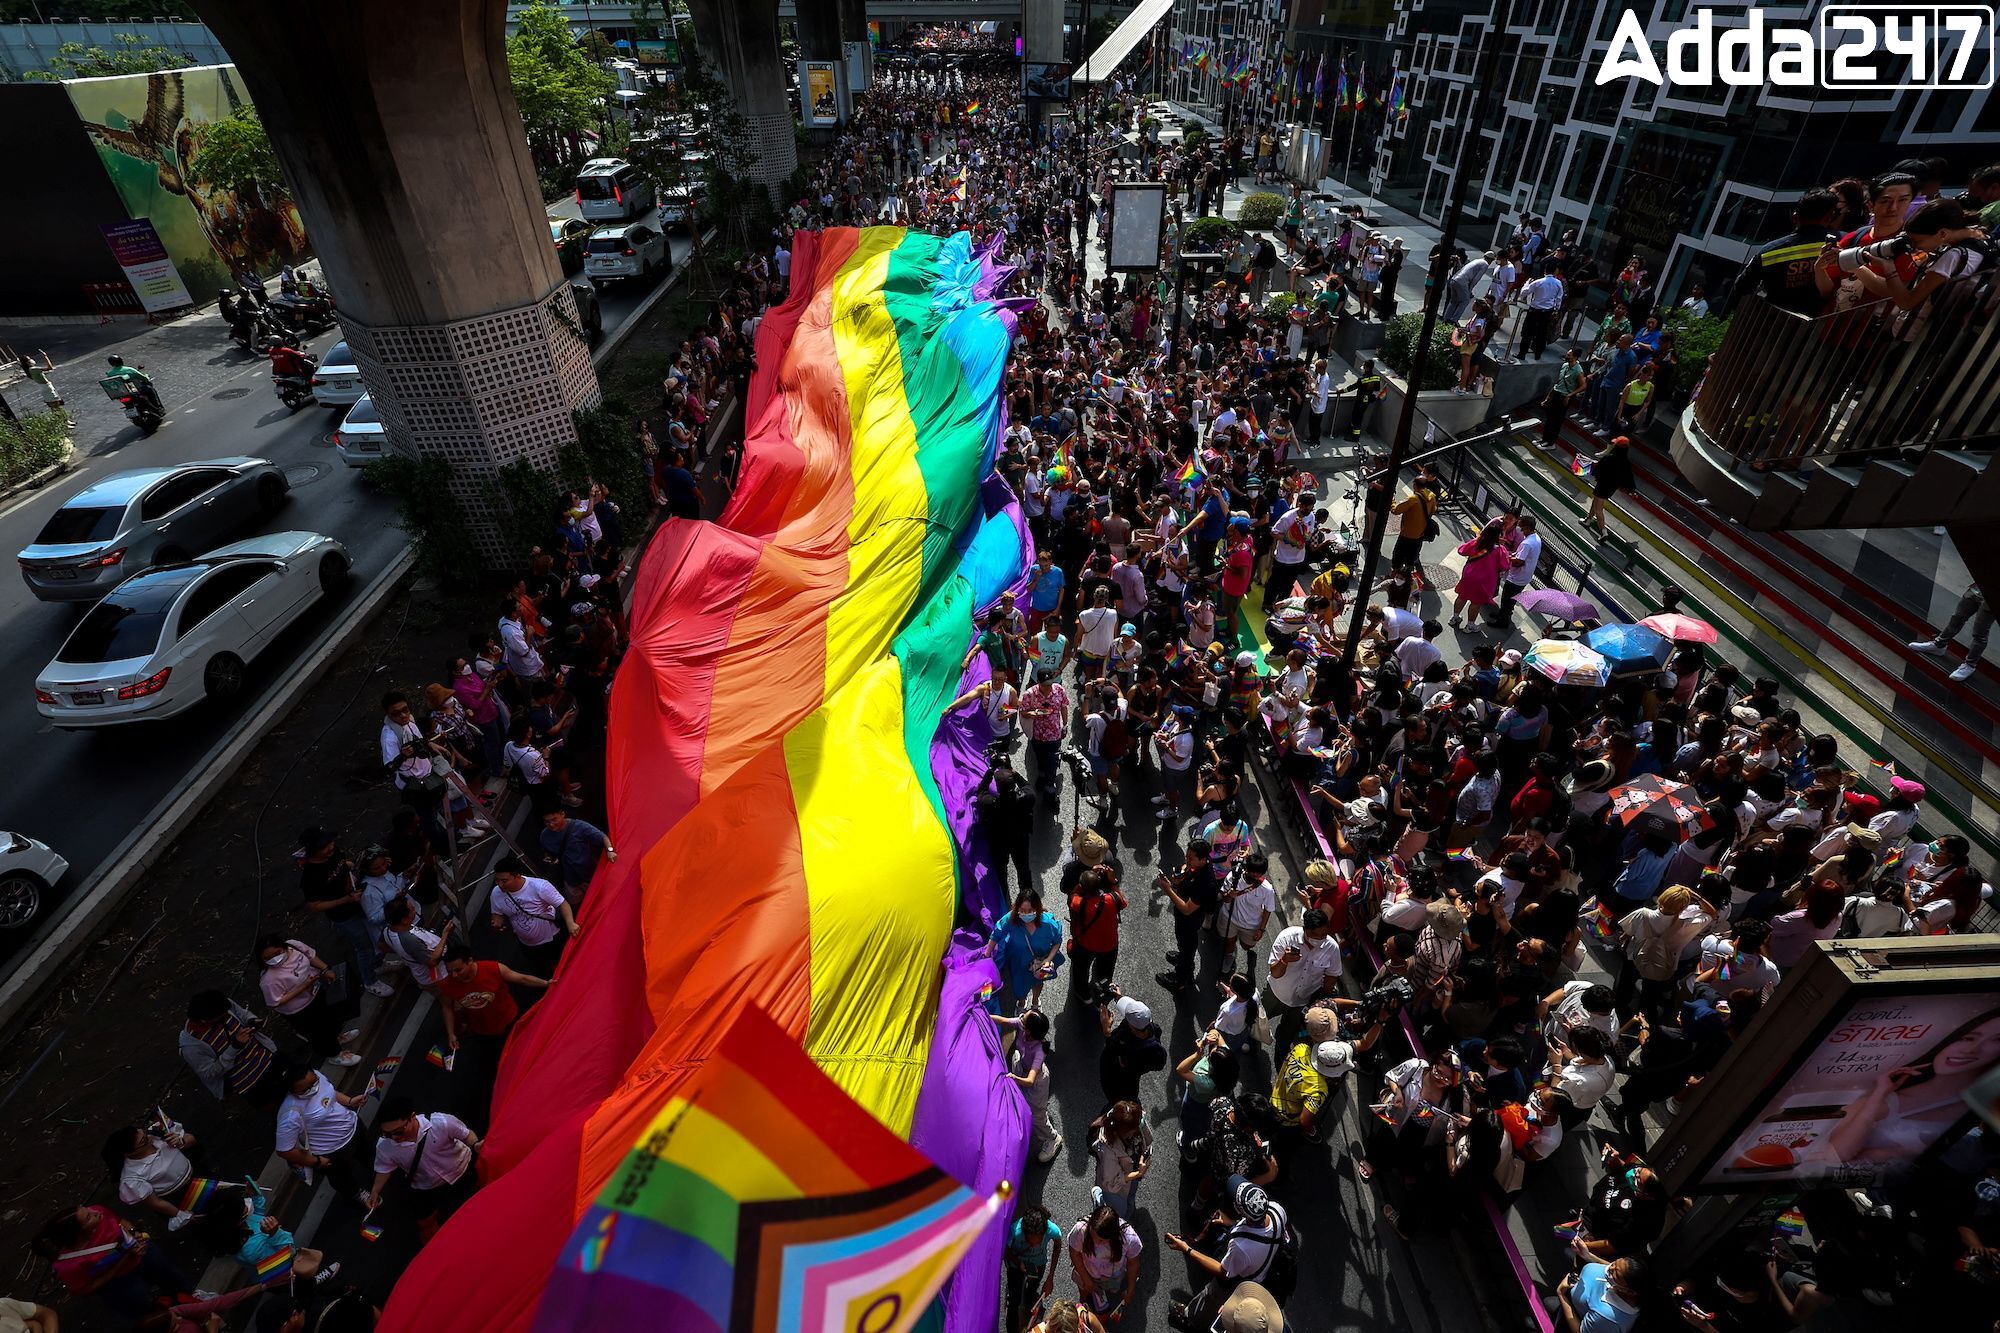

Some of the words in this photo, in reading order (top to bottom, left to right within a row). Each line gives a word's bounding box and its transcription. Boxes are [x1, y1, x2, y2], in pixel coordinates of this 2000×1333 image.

[1044, 655, 1057, 665] 23
[1829, 1024, 1934, 1043] รักเลย
[1816, 1063, 1881, 1075] VISTRA
[1780, 1121, 1815, 1129] VISTRA
